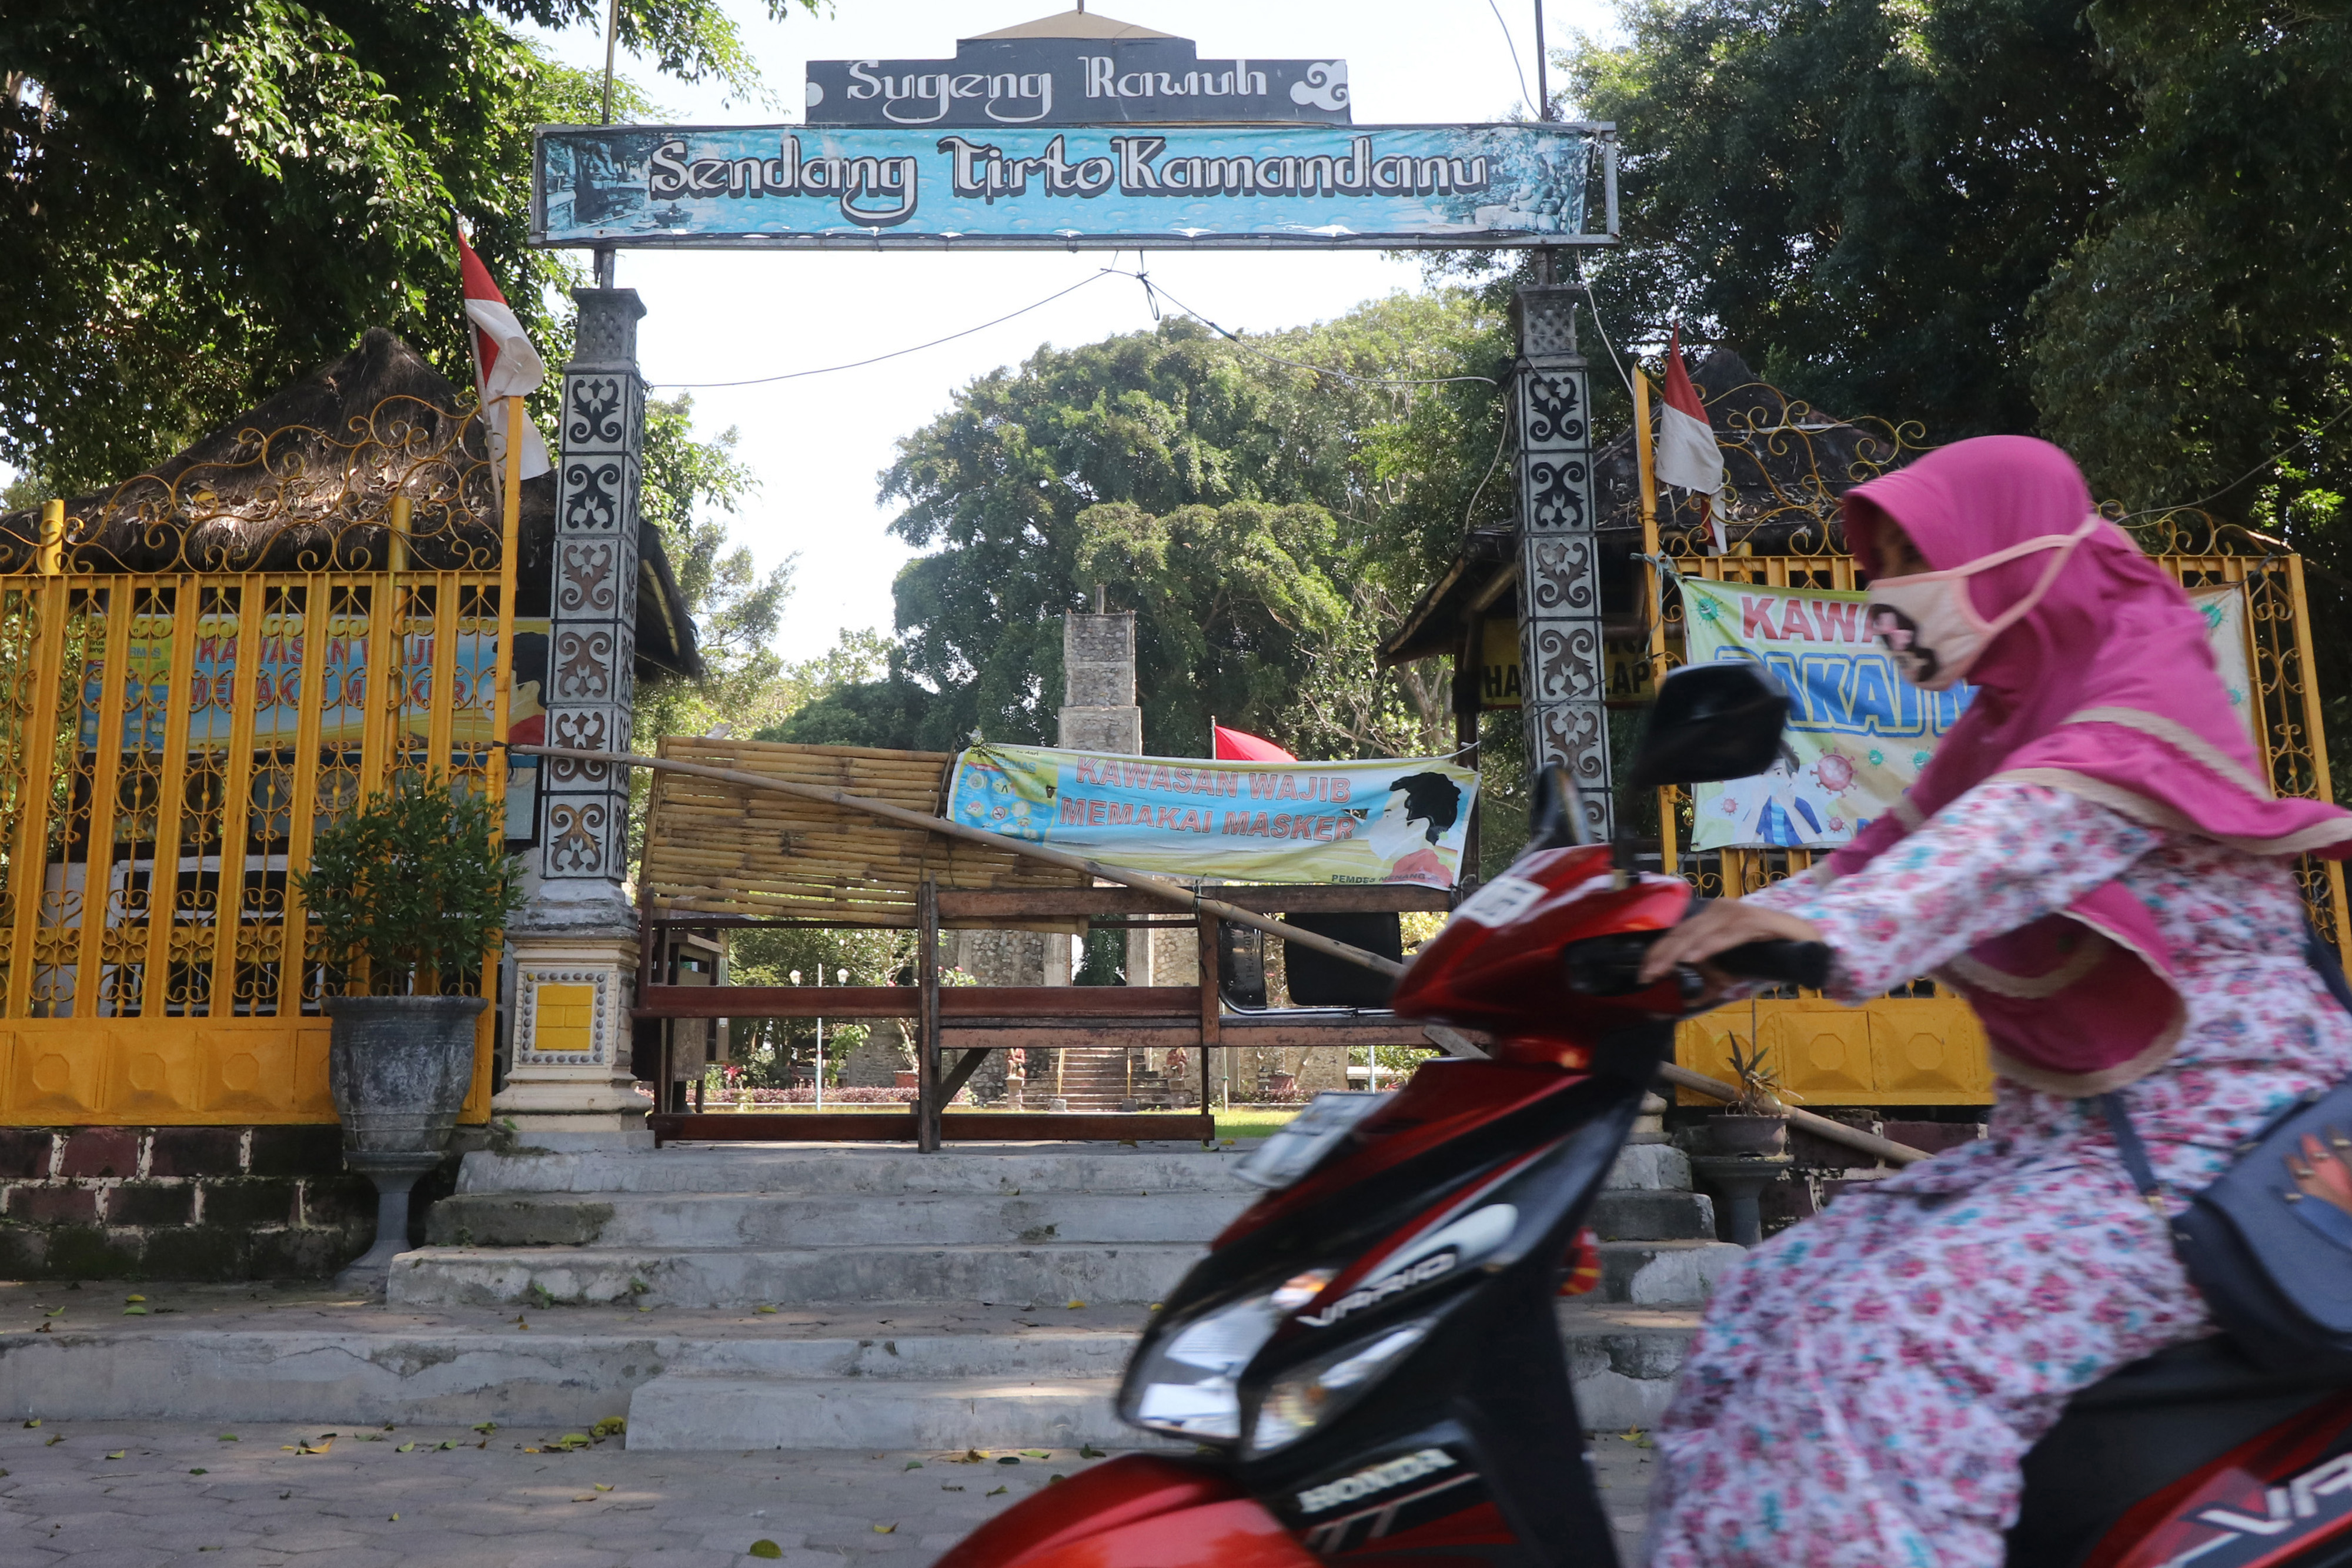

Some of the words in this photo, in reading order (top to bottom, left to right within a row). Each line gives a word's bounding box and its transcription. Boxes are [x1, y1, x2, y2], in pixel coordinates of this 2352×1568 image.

[847, 60, 1052, 123] Sugeng
[1078, 56, 1267, 99] Rawuh
[650, 135, 917, 227] Sendang
[1076, 756, 1239, 798] KAWASAN
[1248, 773, 1351, 803] WAJIB
[1059, 797, 1213, 833] MEMAKAI
[1222, 811, 1356, 842] MASKER
